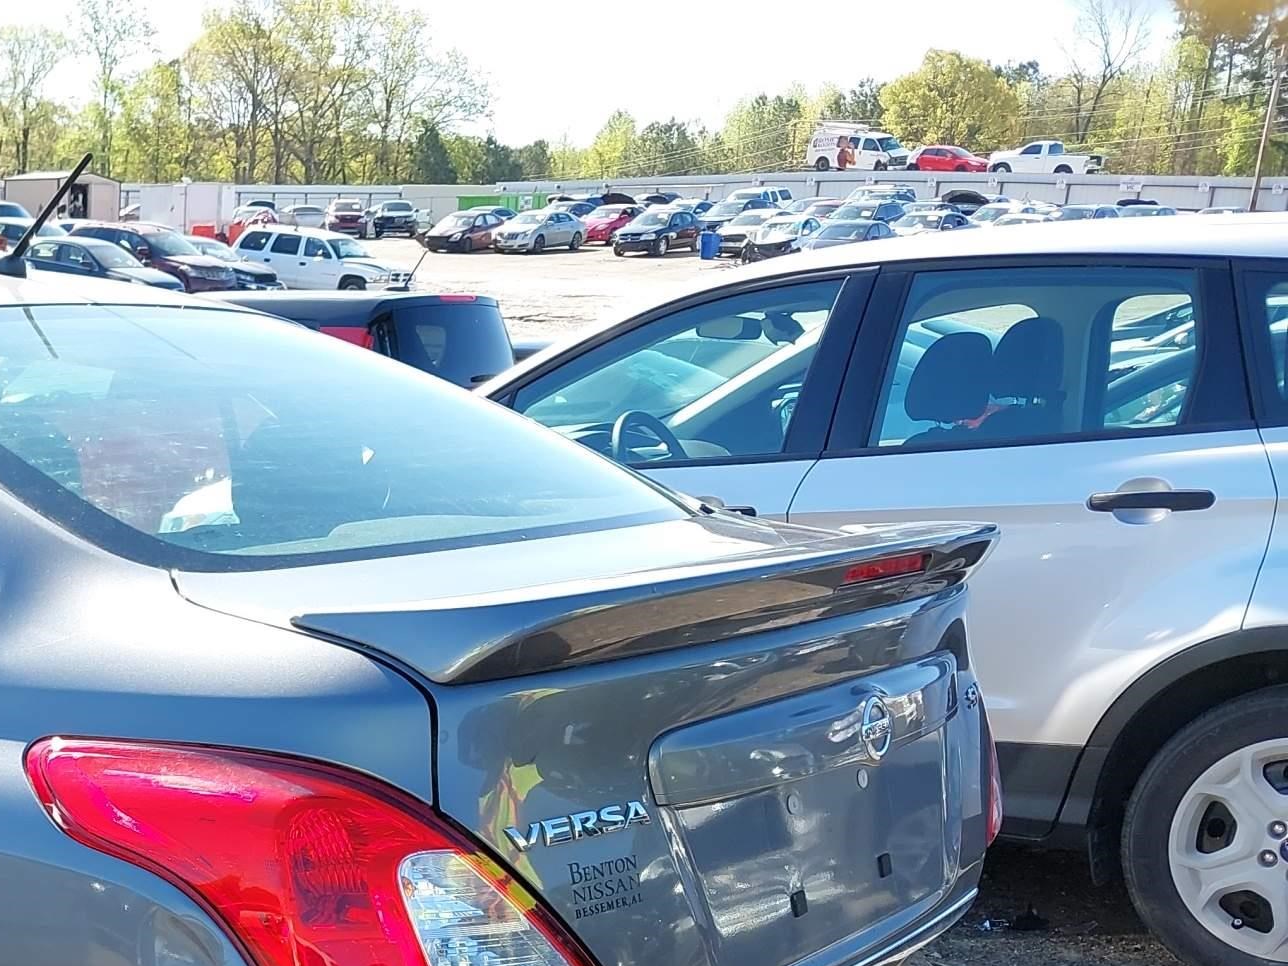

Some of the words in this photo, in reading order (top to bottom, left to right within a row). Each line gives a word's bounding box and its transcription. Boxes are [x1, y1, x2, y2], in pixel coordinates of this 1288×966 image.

[503, 801, 651, 852] VERSA
[568, 854, 638, 886] BENTON
[572, 873, 641, 905] NISSAN
